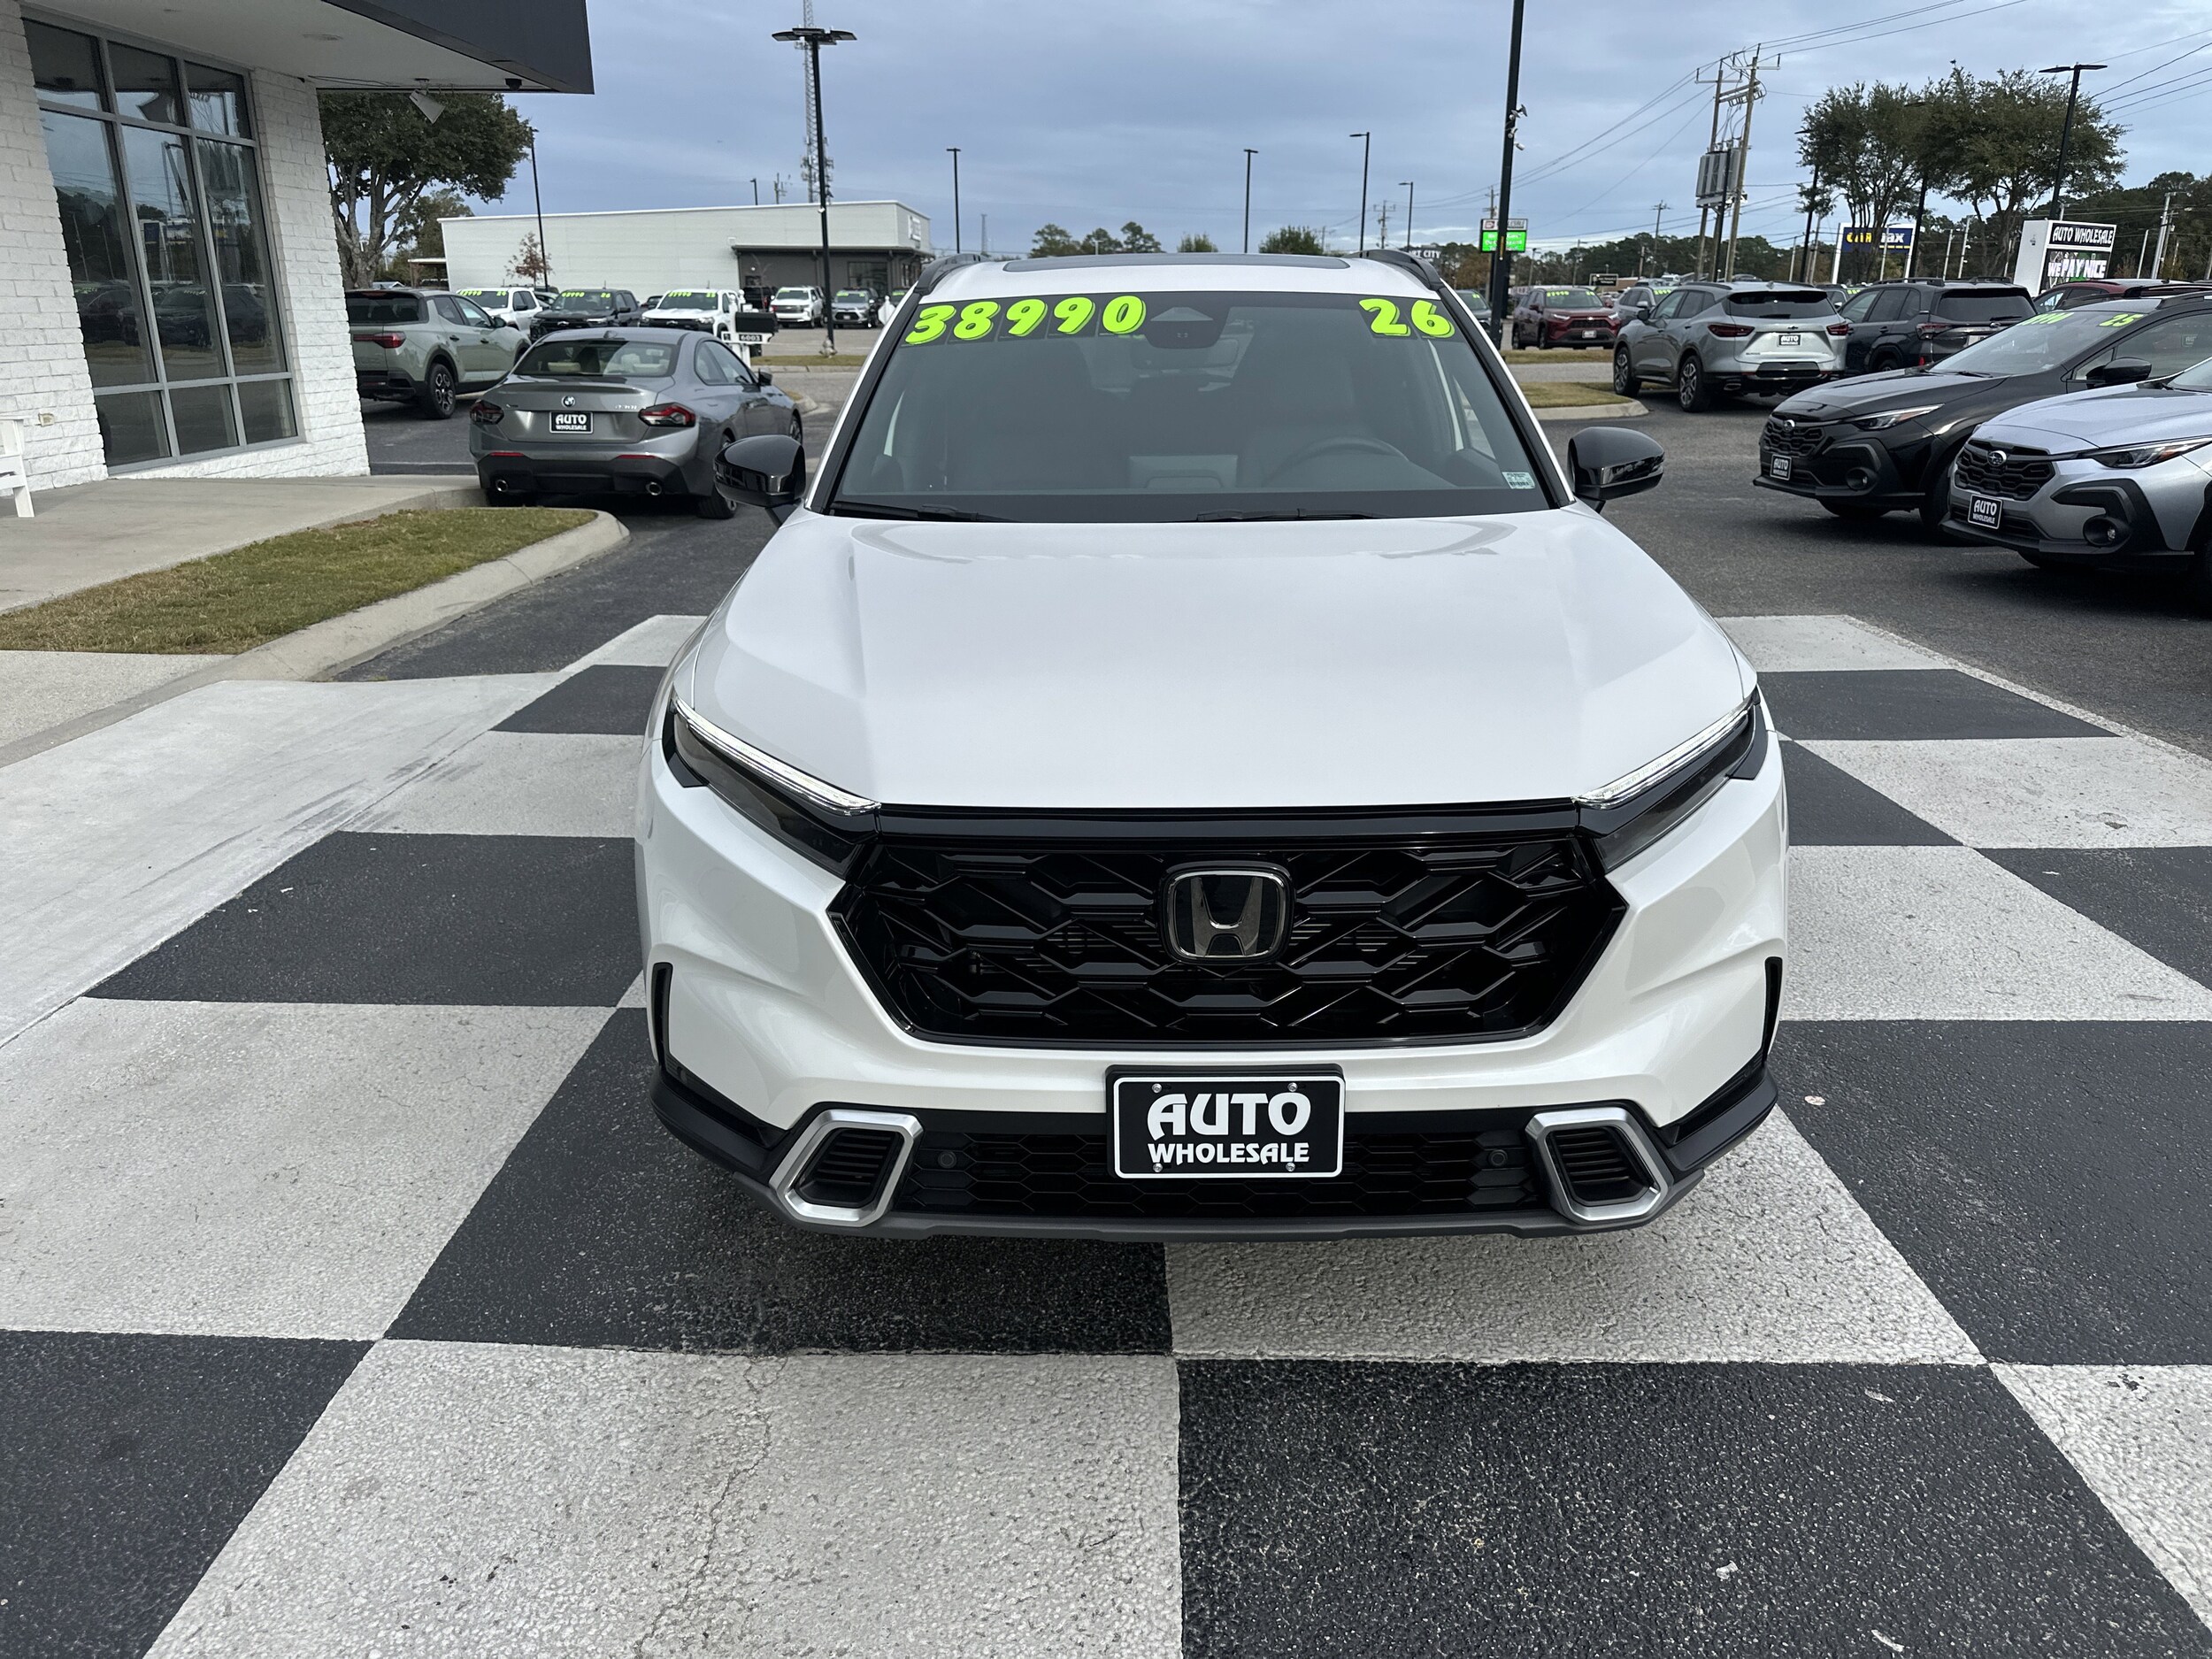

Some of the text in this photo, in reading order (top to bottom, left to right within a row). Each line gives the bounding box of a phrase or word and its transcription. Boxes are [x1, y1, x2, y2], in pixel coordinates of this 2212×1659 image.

[2053, 227, 2113, 244] AUTO WHOLESALE
[1423, 250, 1441, 259] CITY
[2047, 258, 2107, 279] WE PAY NICE
[905, 295, 1455, 344] 38990 26
[2099, 313, 2144, 327] 25
[556, 414, 588, 425] AUTO
[1773, 457, 1789, 471] AUTO
[1974, 499, 1997, 516] AUTO
[1148, 1092, 1311, 1141] AUTO
[1148, 1142, 1310, 1166] WHOLESALE
